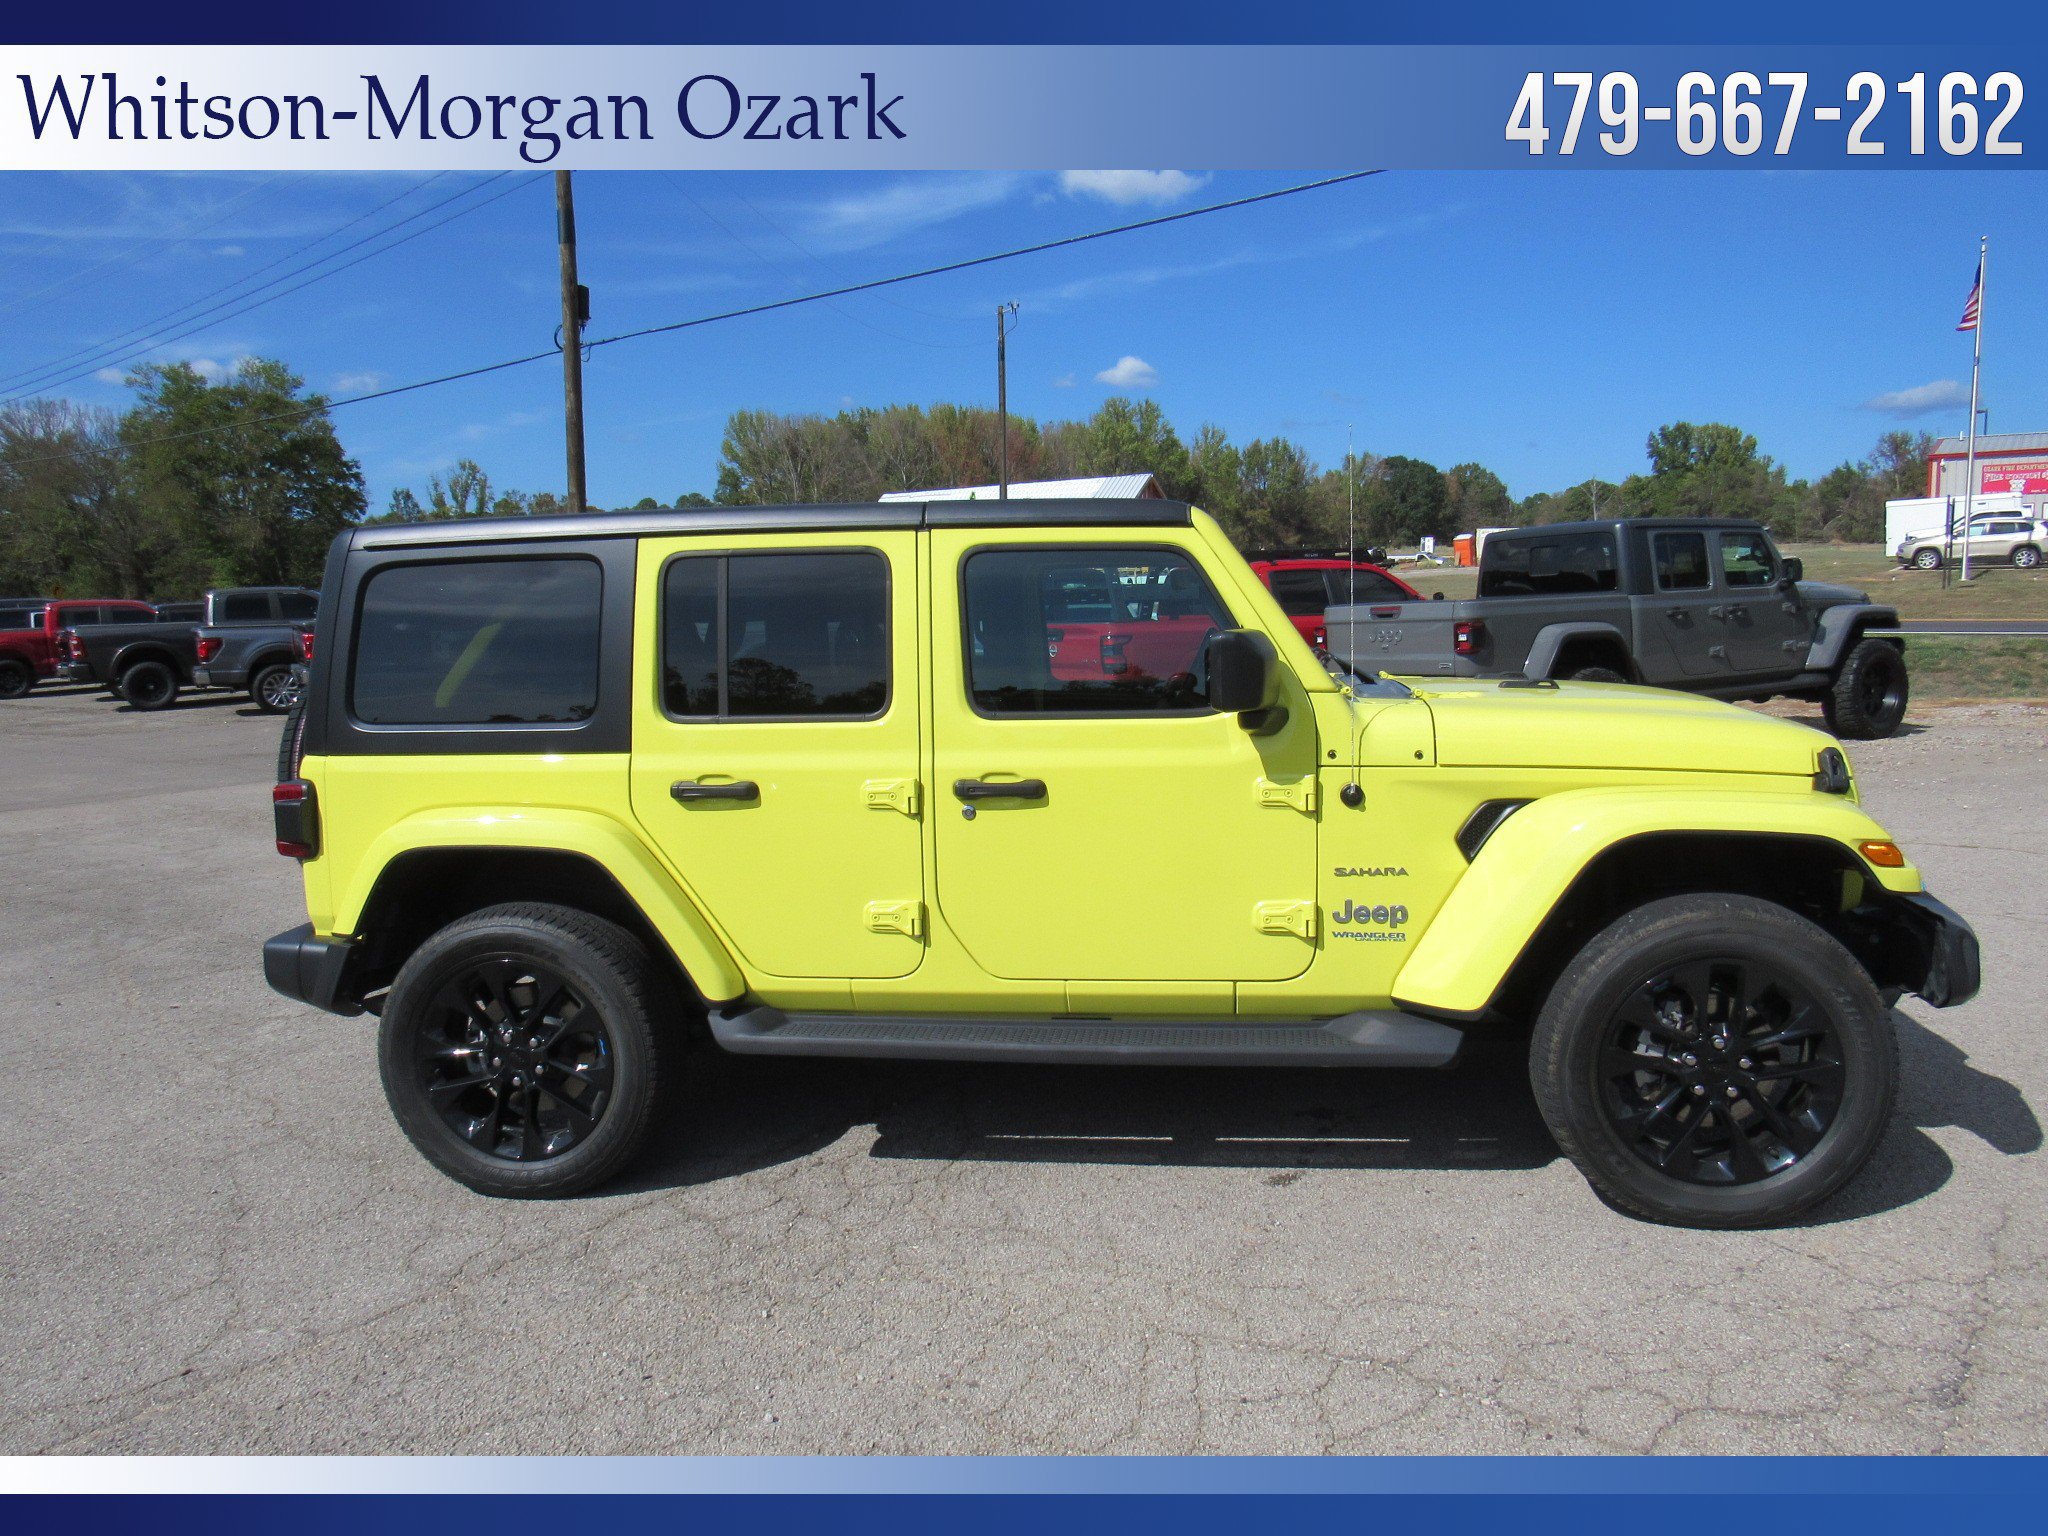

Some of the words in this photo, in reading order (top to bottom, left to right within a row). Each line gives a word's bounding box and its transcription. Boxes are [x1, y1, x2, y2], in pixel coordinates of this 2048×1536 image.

[1333, 867, 1409, 877] SAHARA
[1332, 898, 1409, 929] Jeep
[1331, 931, 1406, 939] WRANGLER
